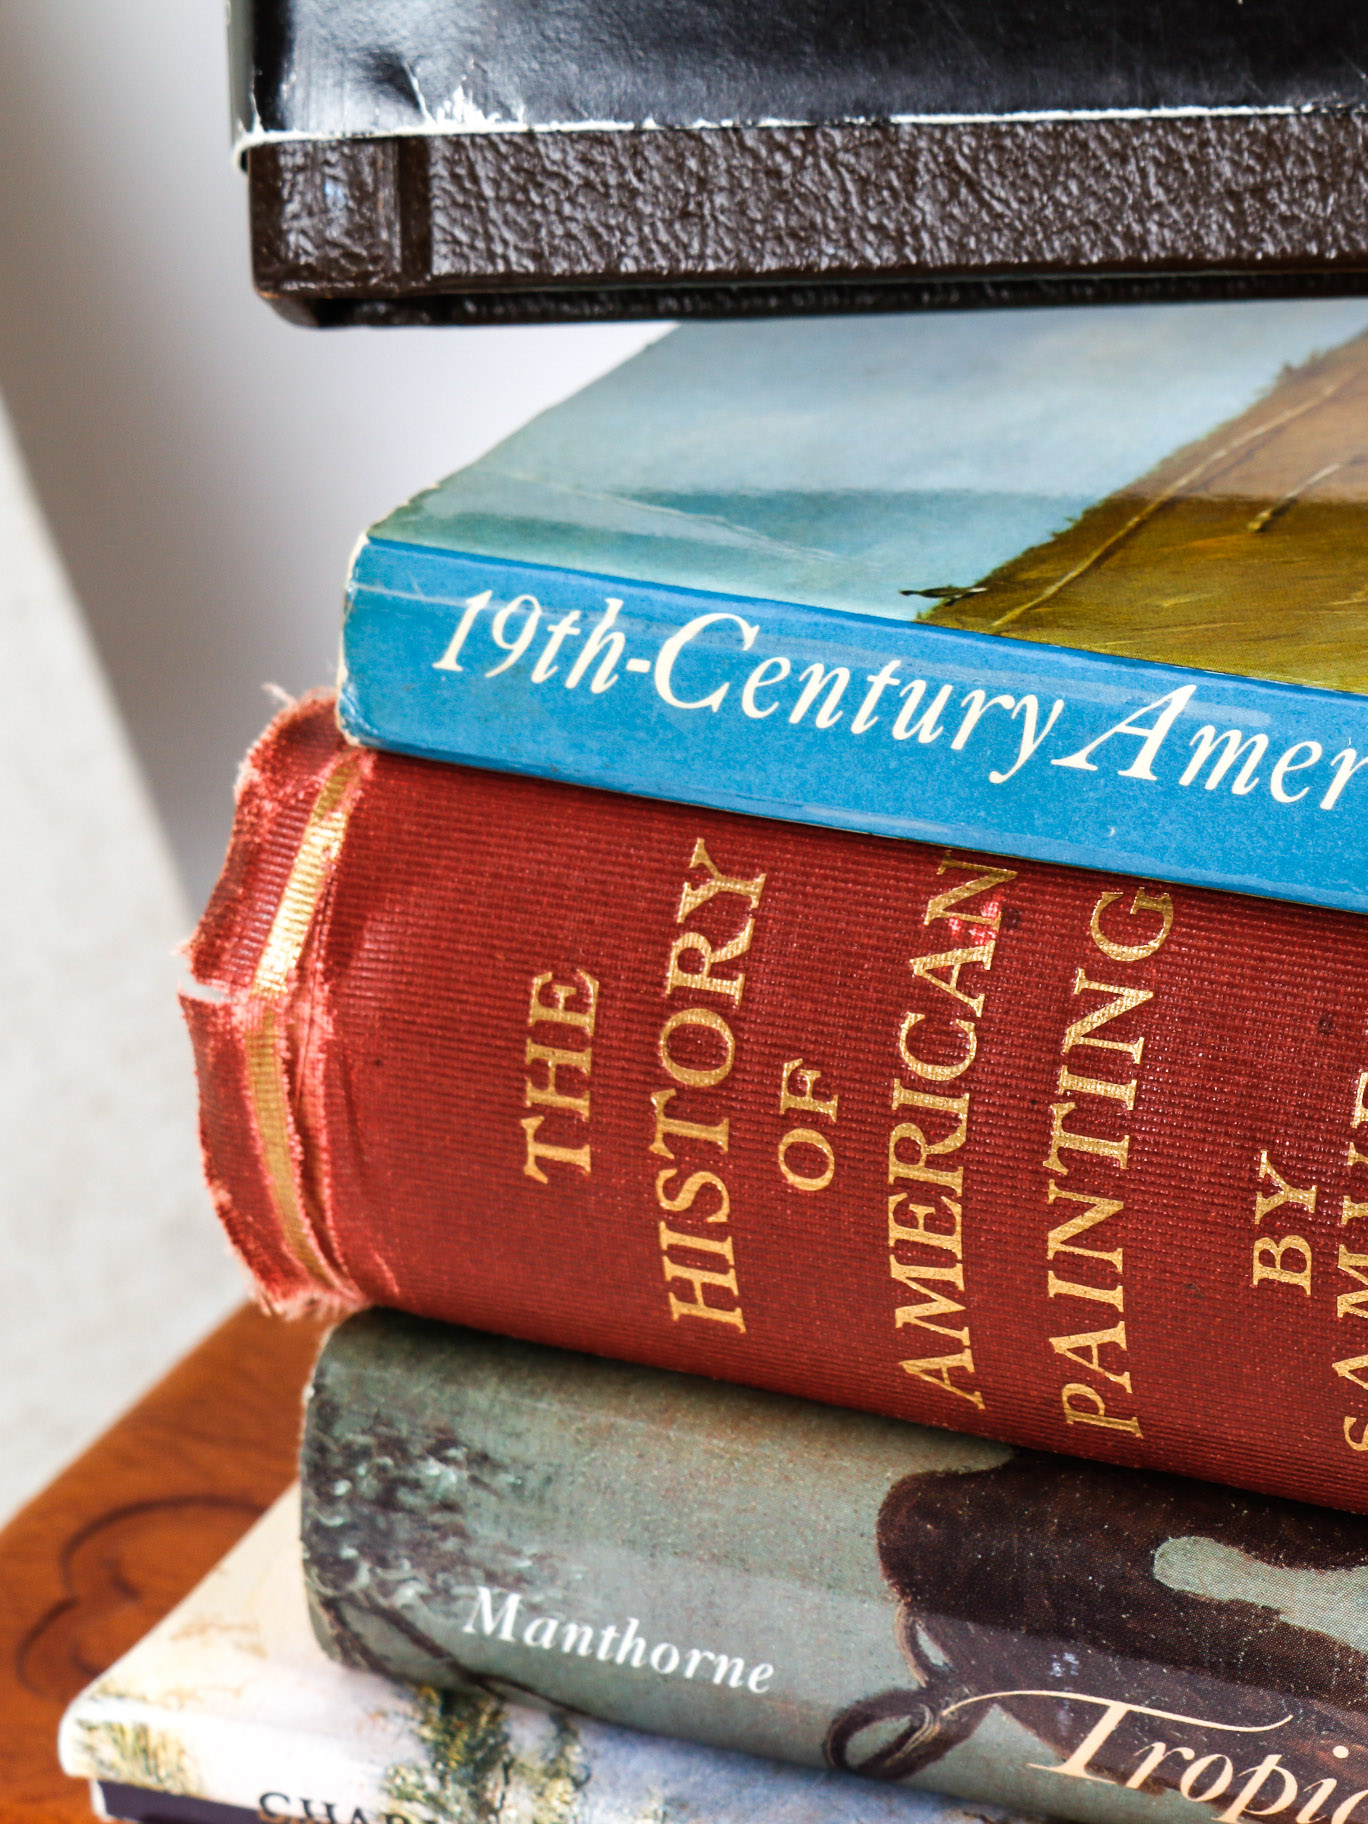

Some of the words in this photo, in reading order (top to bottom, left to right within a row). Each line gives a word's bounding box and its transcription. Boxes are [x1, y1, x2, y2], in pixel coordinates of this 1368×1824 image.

[433, 589, 1064, 784] 19th-Century
[520, 969, 600, 1183] THE
[649, 838, 767, 1333] HISTORY
[777, 1059, 839, 1191] OF
[888, 850, 1018, 1410] AMERICAN
[1042, 886, 1174, 1439] PAINTING
[1250, 1149, 1317, 1297] BY
[462, 1586, 775, 1694] Manthorne
